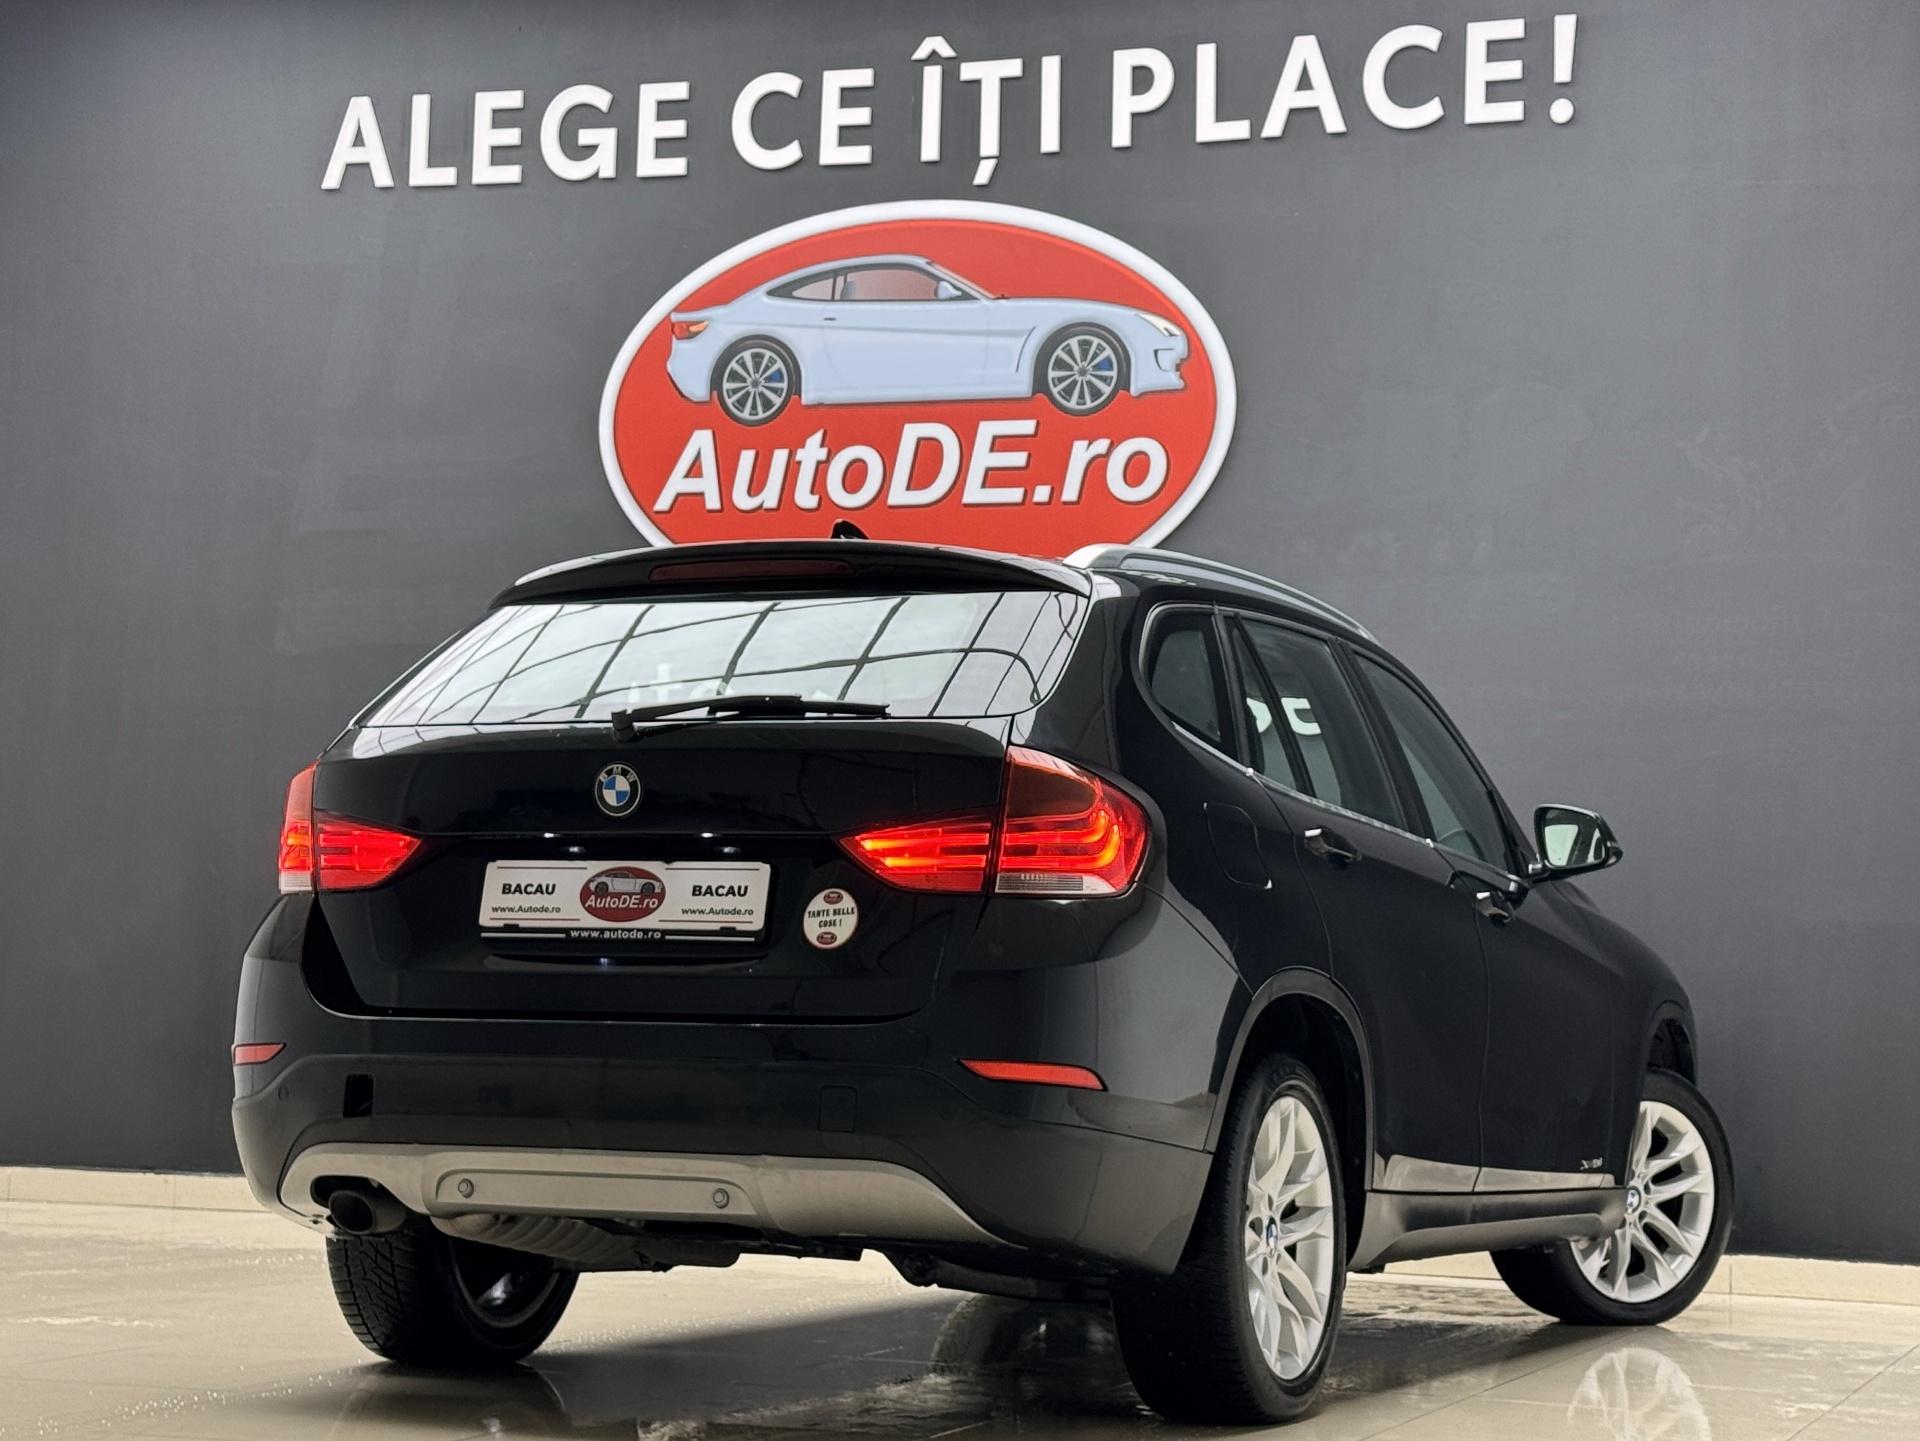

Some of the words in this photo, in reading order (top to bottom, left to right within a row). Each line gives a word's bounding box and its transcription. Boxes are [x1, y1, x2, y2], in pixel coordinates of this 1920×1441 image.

[321, 81, 690, 190] ALEGE
[731, 68, 875, 170] CE
[1111, 14, 1579, 149] PLACE!
[653, 418, 1169, 513] AutoDE.ro
[501, 883, 556, 895] BACAU
[691, 885, 748, 897] BACAU
[585, 895, 659, 909] AutoDE.ro
[491, 905, 561, 913] www.Autode.ro
[681, 907, 754, 916] www.Autode.ro
[570, 929, 662, 939] www.autode.ro
